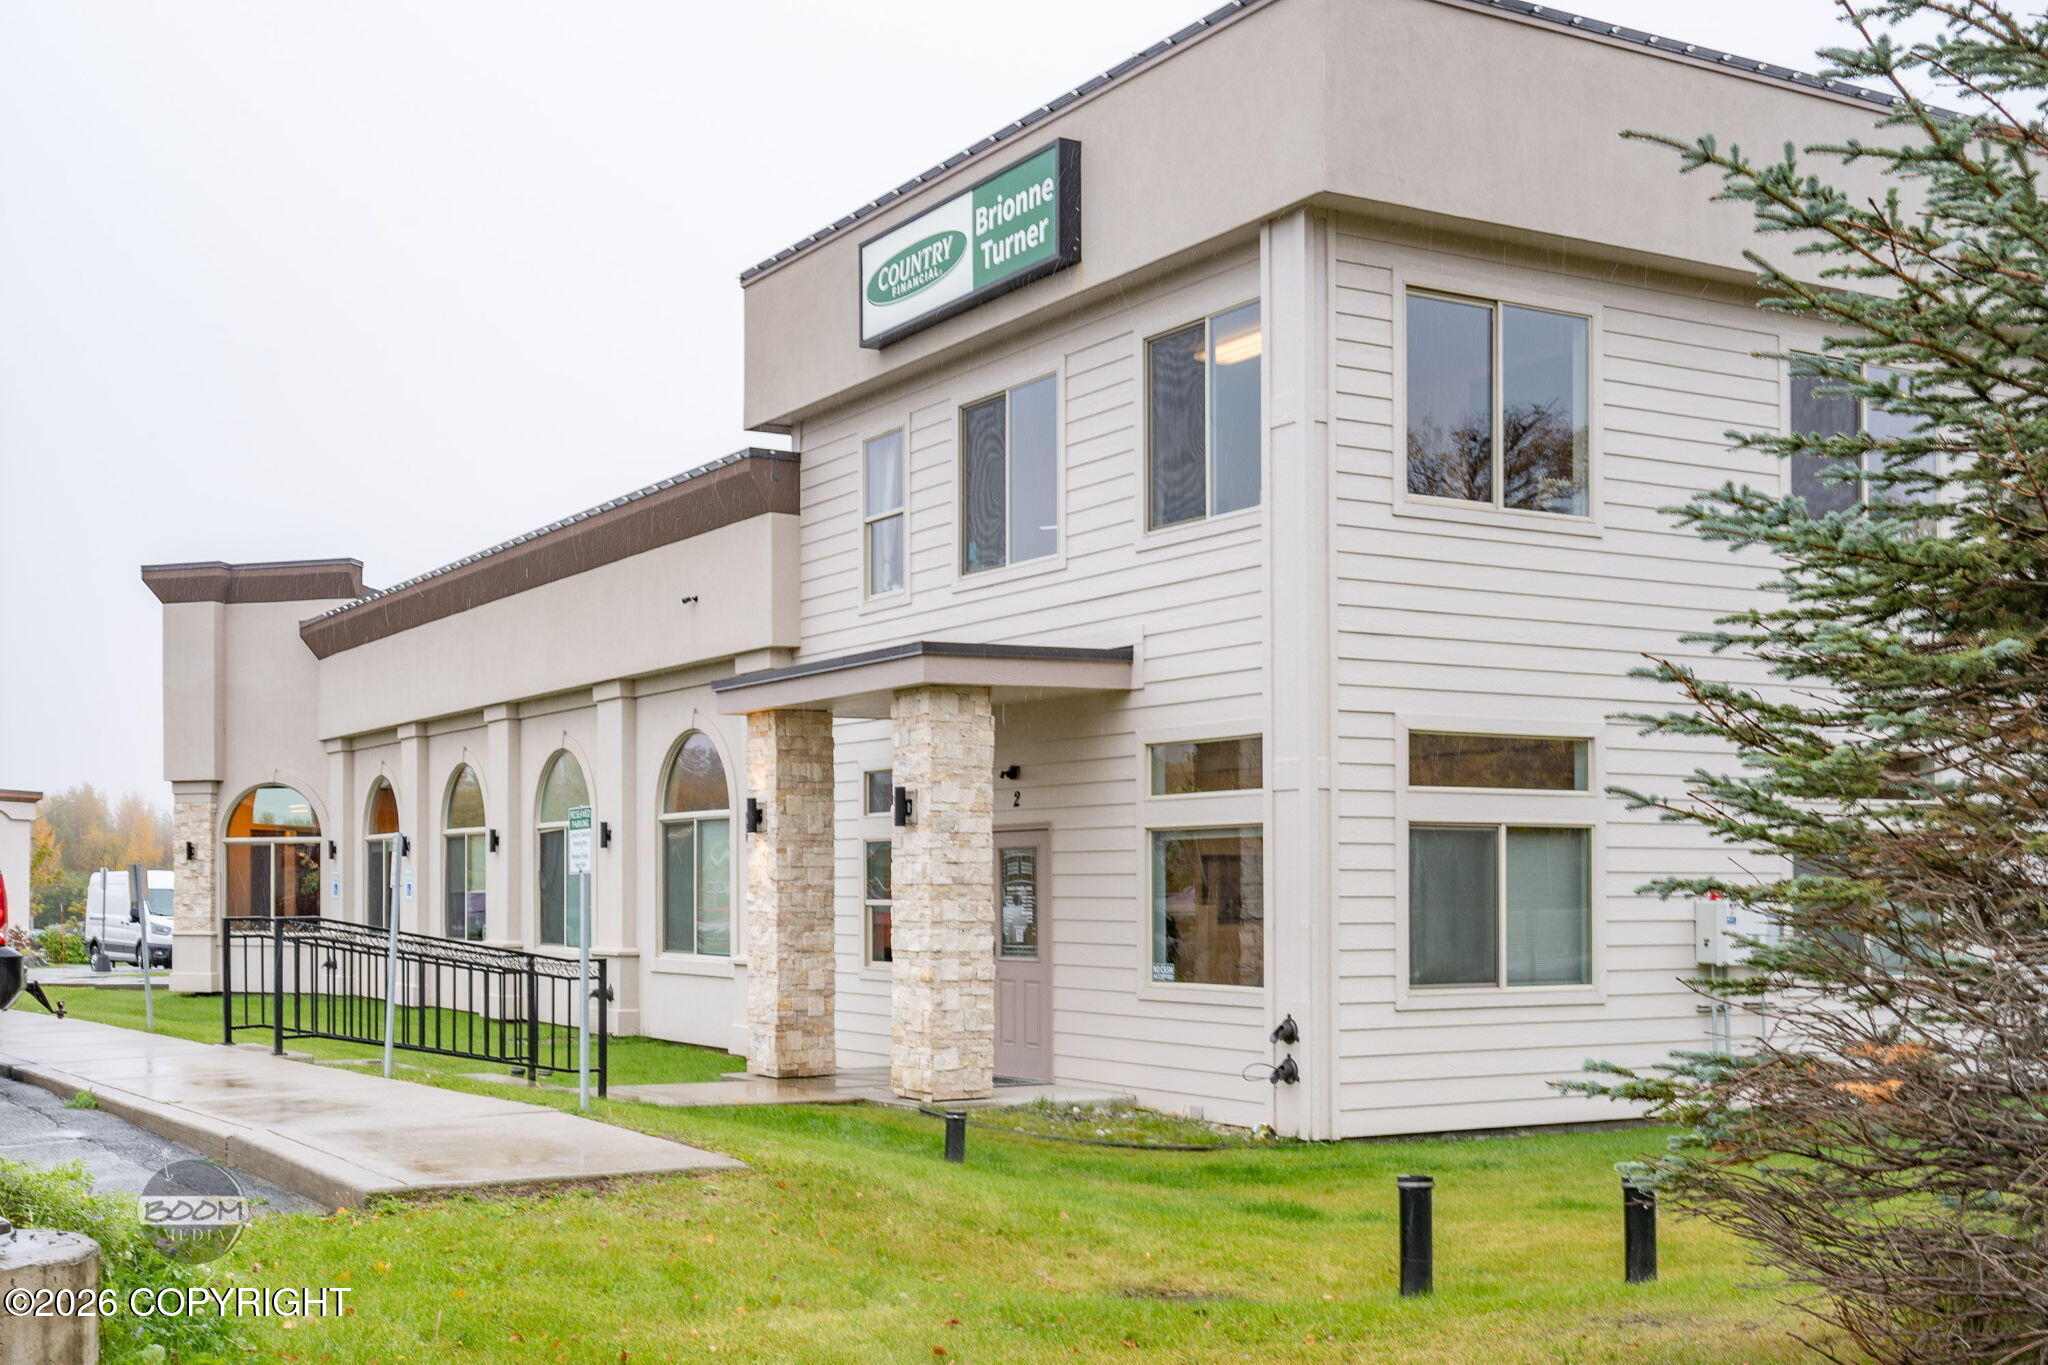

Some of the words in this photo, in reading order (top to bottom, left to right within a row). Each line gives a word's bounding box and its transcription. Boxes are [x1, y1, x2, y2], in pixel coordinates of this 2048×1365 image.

[975, 177, 1055, 237] Brionne
[877, 235, 954, 292] COUNTRY
[980, 217, 1050, 270] Turner
[891, 267, 940, 298] FINANCIAL
[1013, 790, 1020, 807] 2
